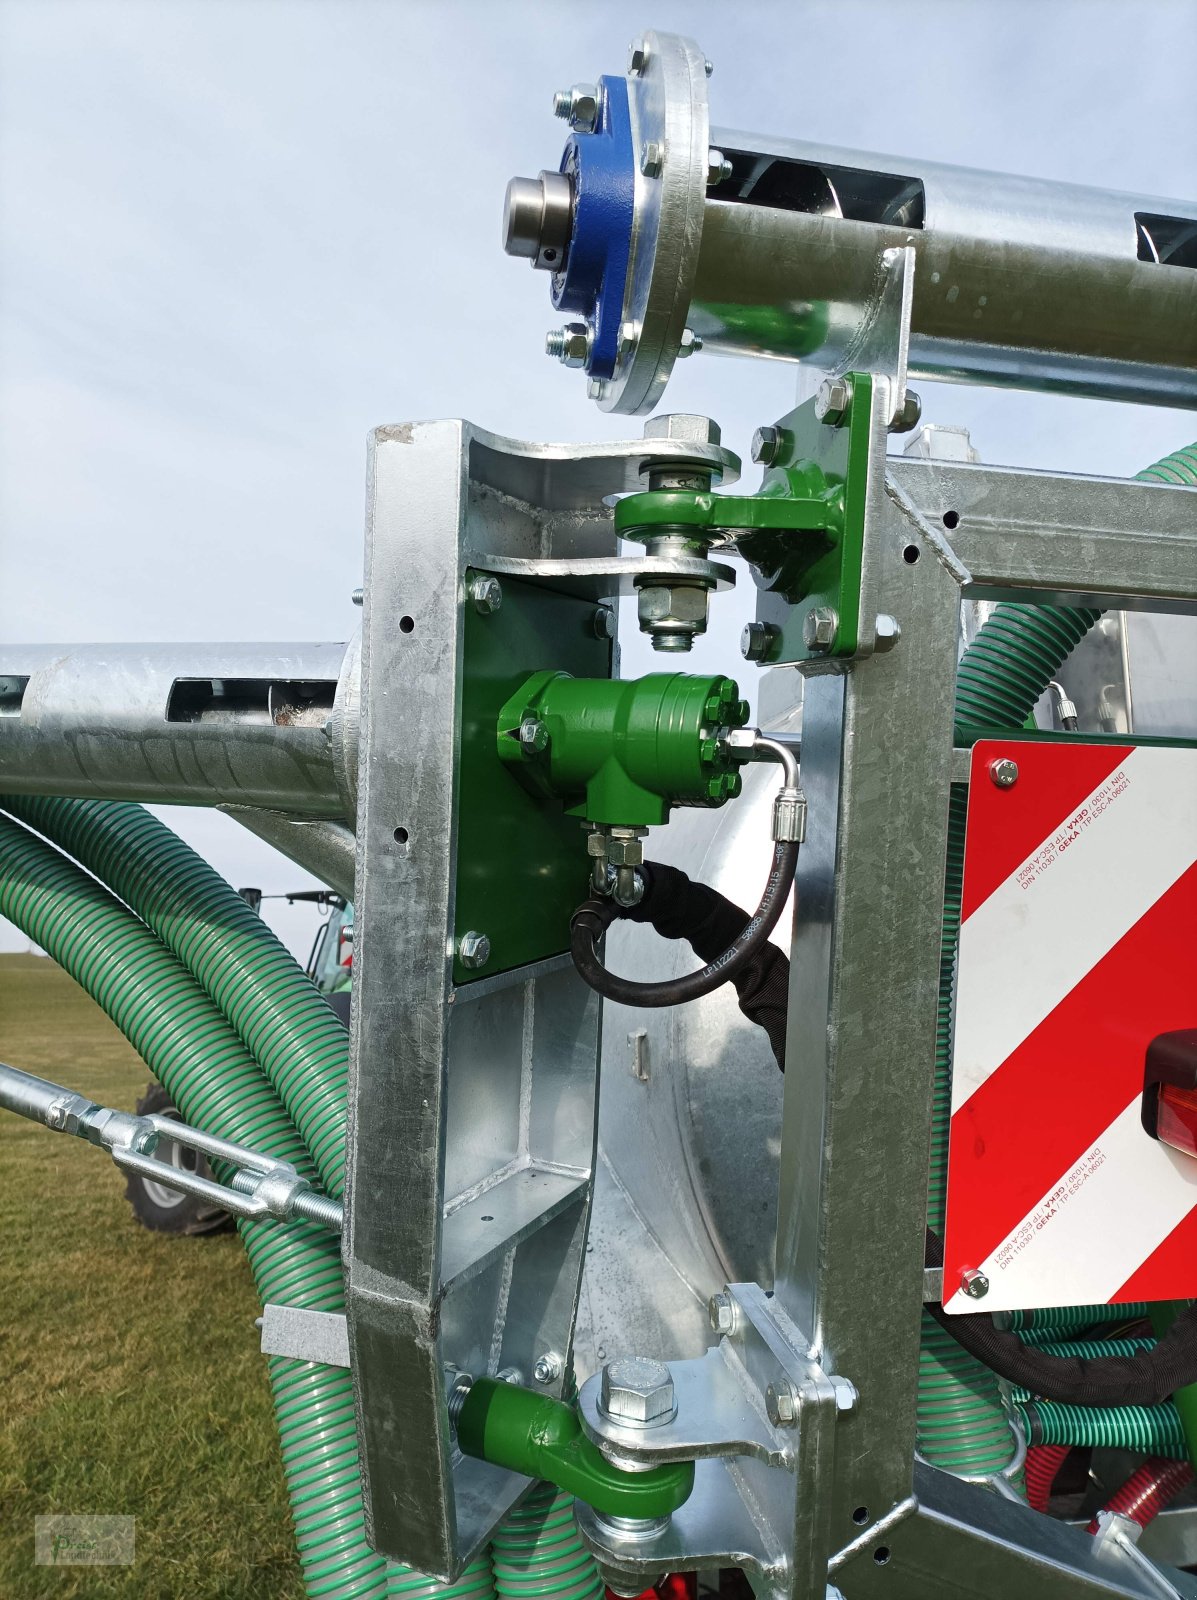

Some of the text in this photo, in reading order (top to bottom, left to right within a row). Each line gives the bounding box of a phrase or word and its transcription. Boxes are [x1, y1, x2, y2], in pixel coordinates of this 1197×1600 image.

[1111, 771, 1125, 787] DIN
[1091, 786, 1111, 806] 11030
[1067, 809, 1088, 830] GEKA
[1021, 874, 1035, 890] DIN
[1035, 854, 1055, 875] 11030
[1058, 831, 1080, 852] GEKA
[1082, 816, 1092, 827] TP
[1091, 797, 1114, 819] ESC-A
[1111, 778, 1131, 798] 06021
[1055, 834, 1065, 845] TP
[1033, 842, 1056, 864] ESC-A
[1016, 863, 1035, 883] 06021
[702, 946, 739, 977] LP112221
[759, 871, 780, 913] 14:19:15
[1087, 1148, 1101, 1163] DIN
[1068, 1163, 1087, 1183] 11030
[1044, 1187, 1065, 1208] GEKA
[999, 1254, 1014, 1270] DIN
[1013, 1233, 1033, 1254] 11030
[1036, 1208, 1057, 1230] GEKA
[1059, 1193, 1069, 1204] TP
[1068, 1173, 1090, 1195] ESC-A
[1088, 1154, 1107, 1174] 06021
[1033, 1213, 1042, 1223] TP
[1011, 1221, 1033, 1244] ESC-A
[994, 1243, 1013, 1264] 06021
